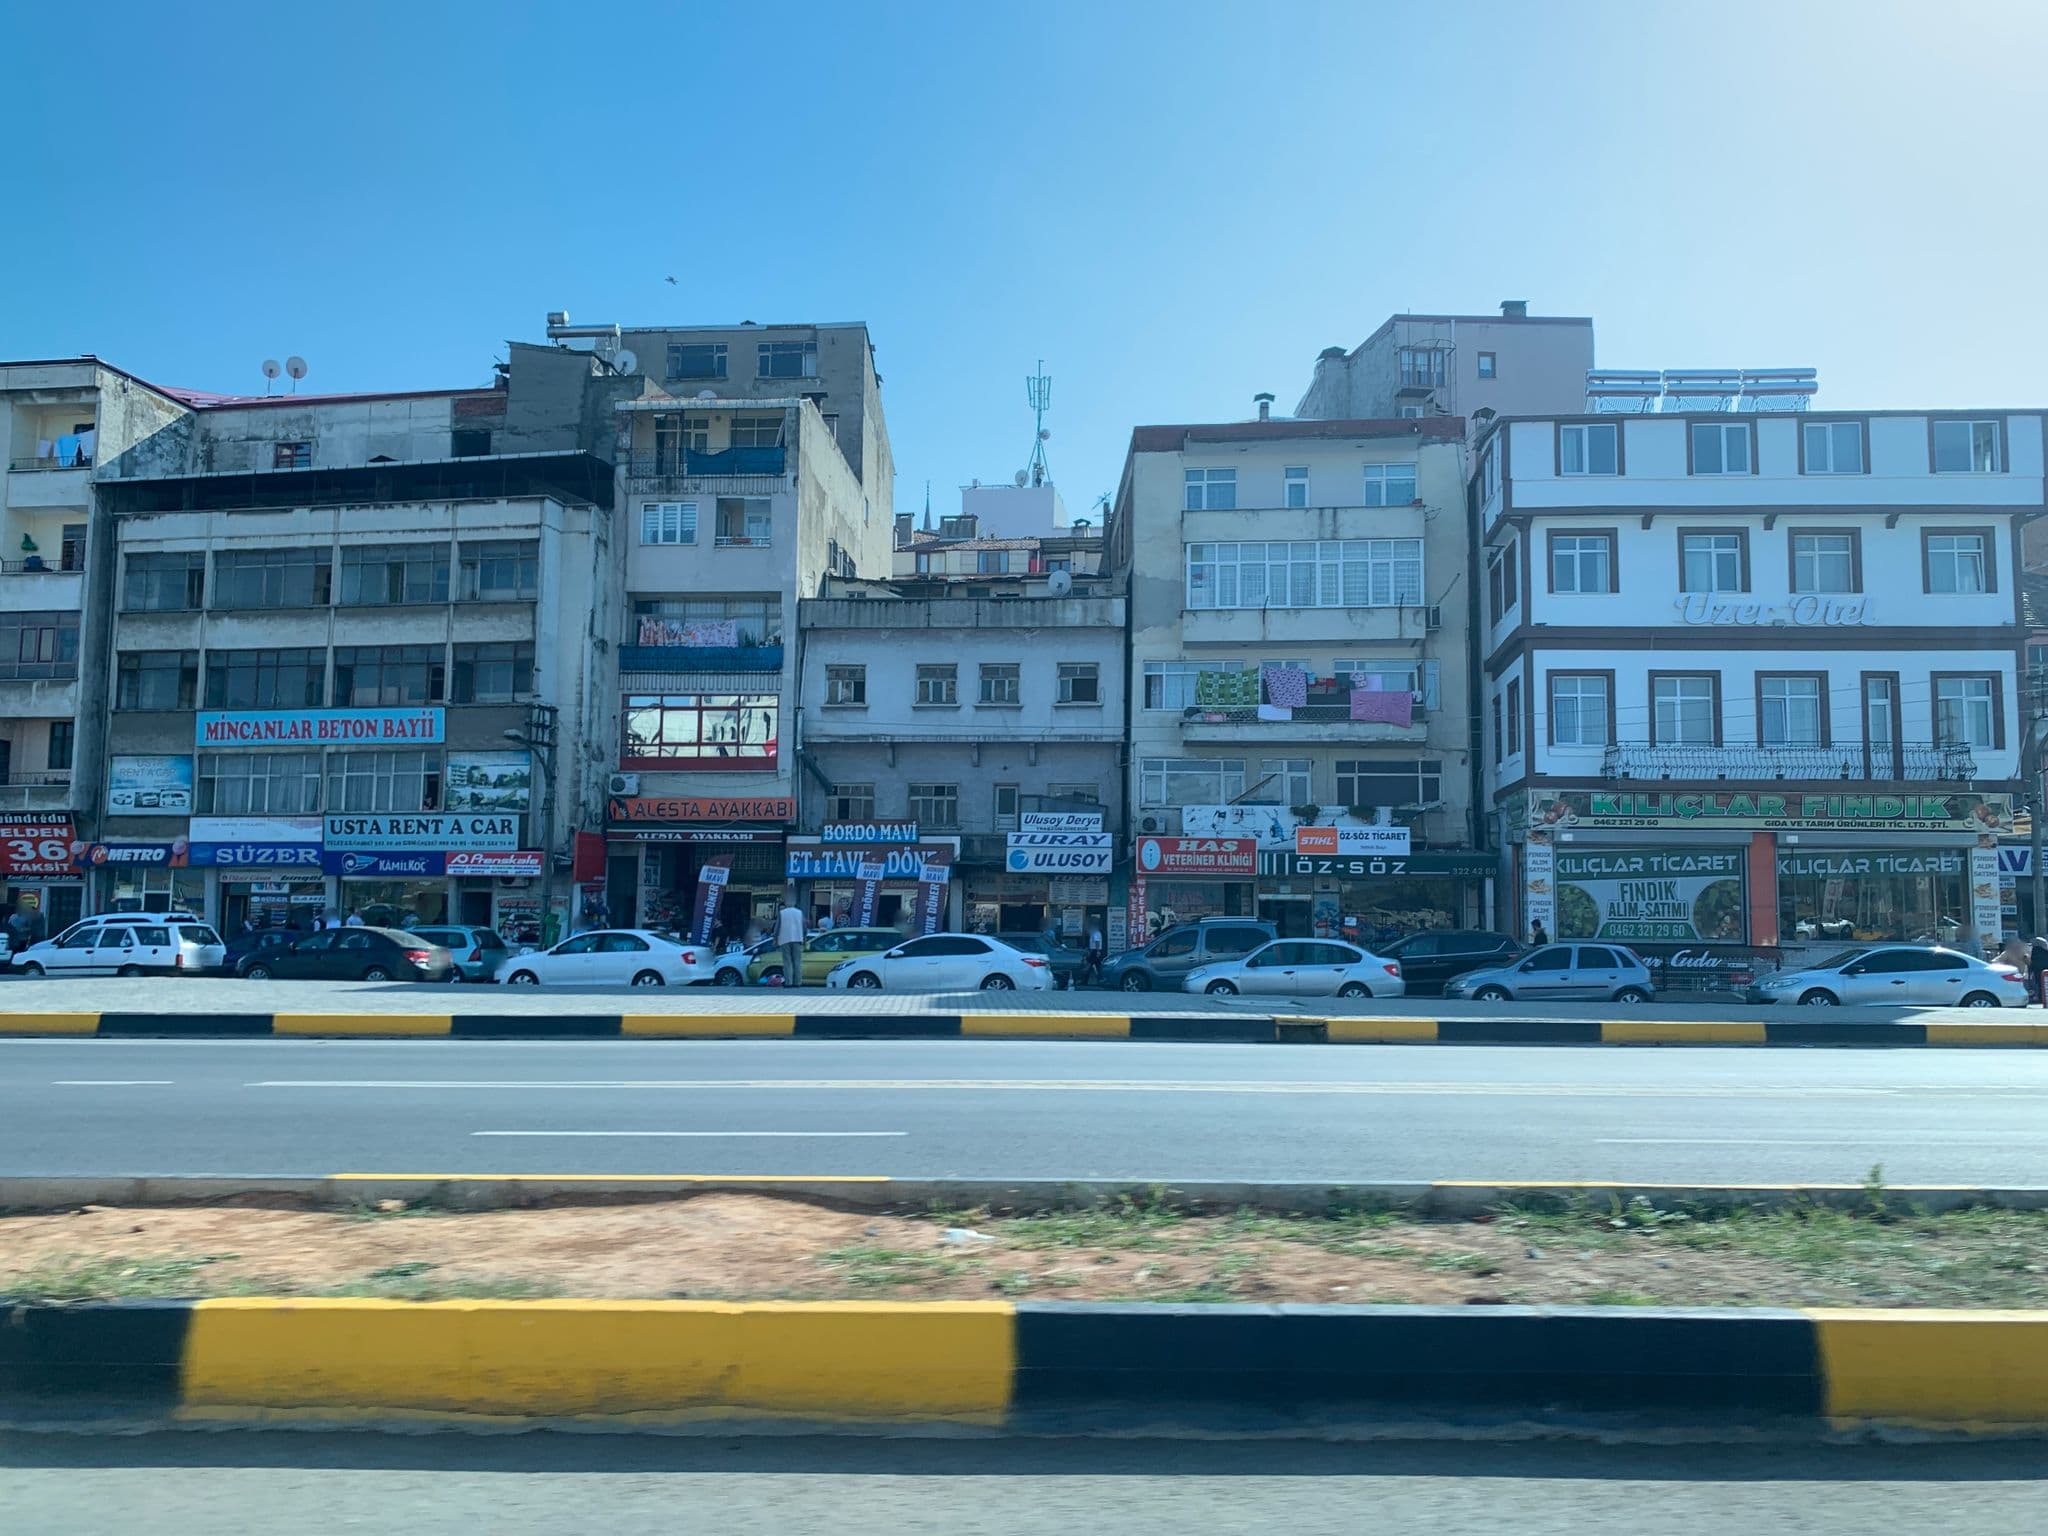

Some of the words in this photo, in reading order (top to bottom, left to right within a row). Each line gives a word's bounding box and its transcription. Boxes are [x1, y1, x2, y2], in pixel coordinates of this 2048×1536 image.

[205, 713, 313, 741] MİNCANLAR
[318, 718, 378, 740] BETON
[382, 710, 434, 738] BAYİİ
[634, 801, 700, 817] ALESTA
[707, 801, 793, 817] AYAKKABI
[1590, 791, 1788, 821] KILIÇLAR
[1801, 792, 1952, 818] FINDIK
[0, 812, 67, 824] ündoğdu
[1024, 814, 1064, 827] Ulusoy
[1066, 814, 1101, 827] Derya
[1764, 820, 1787, 828] GIDA
[1790, 820, 1804, 828] VE
[1805, 820, 1835, 828] TARIM
[1836, 819, 1886, 828] ÜRÜNLERİ
[1887, 820, 1906, 829] TİC.
[1908, 821, 1929, 829] LTD.
[1930, 820, 1949, 830] ŞTİ.
[0, 827, 69, 838] ELDEN
[329, 819, 383, 835] USTA
[388, 818, 444, 835] RENT
[446, 818, 465, 834] A
[470, 818, 514, 835] CAR
[823, 824, 876, 840] BORDO
[880, 820, 917, 840] MAVİ
[1011, 834, 1108, 846] TURAY
[1301, 836, 1334, 846] STIHL
[1339, 830, 1370, 841] ÖZ-SÖZ
[1371, 830, 1407, 841] TİCARET
[7, 839, 69, 861] 36
[1177, 840, 1239, 852] HAS
[107, 848, 166, 862] METRO
[216, 844, 321, 866] SÜZER
[789, 851, 813, 874] ET
[814, 859, 821, 873] &
[887, 846, 938, 874] DÖN
[1034, 852, 1110, 867] ULUSOY
[1163, 852, 1215, 866] VETERİNER
[1217, 852, 1253, 867] KLİNİĞİ
[1649, 852, 1737, 872] TİCARET
[10, 862, 70, 872] TAKSİT
[1296, 855, 1407, 874] ÖZ-SÖZ
[1778, 858, 1870, 879] KILIÇLAR
[1875, 854, 1965, 874] TİCARET
[704, 884, 720, 915] DÖNER
[861, 880, 877, 911] DÖNER
[927, 884, 941, 915] DÖNER
[1620, 881, 1677, 902] FINDIK
[1607, 903, 1688, 919] ALIM-SATIMI
[1609, 924, 1634, 937] 0462
[1637, 924, 1654, 936] 321
[1656, 924, 1669, 936] 29
[1672, 924, 1685, 936] 60
